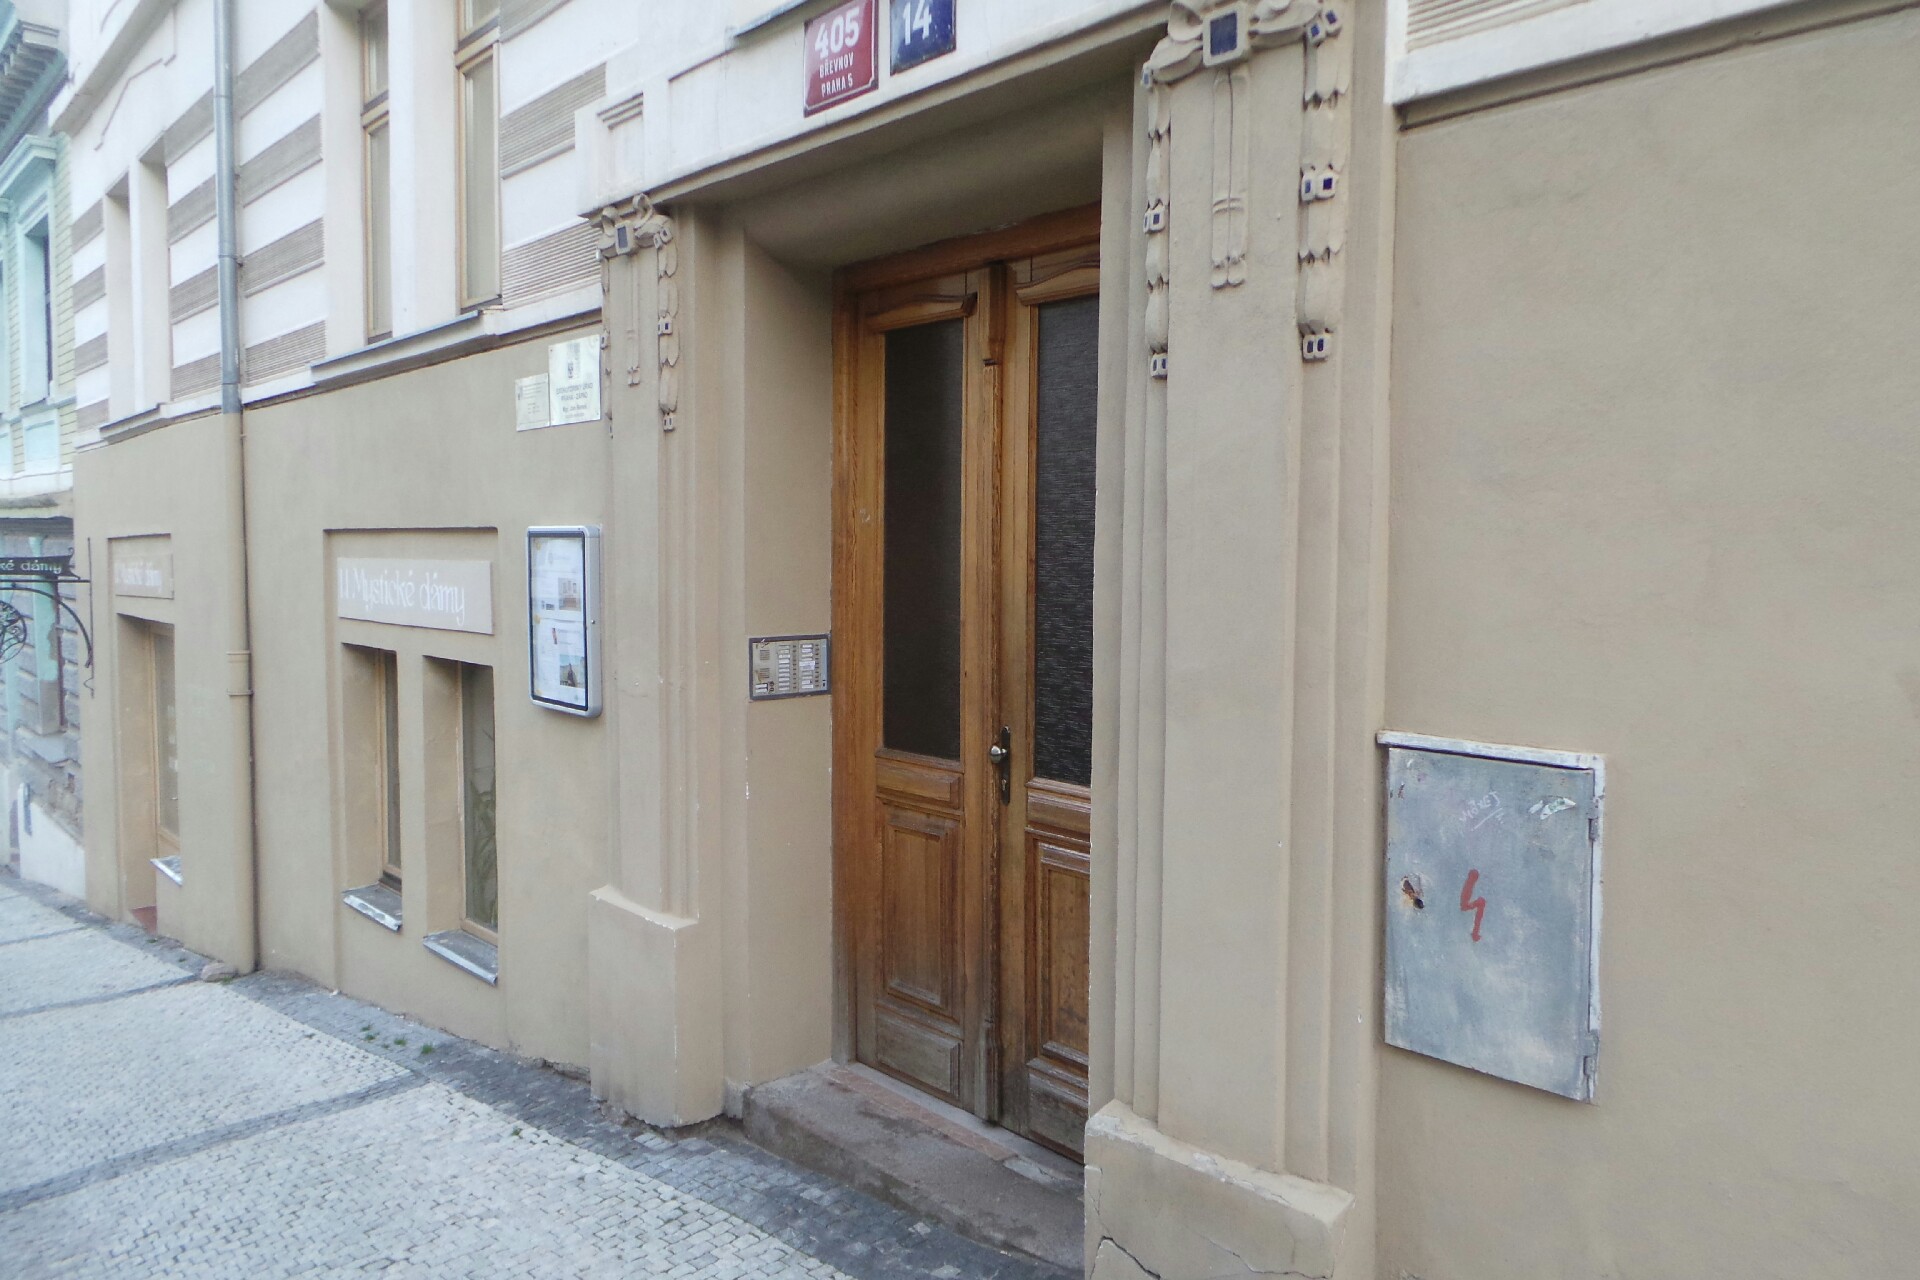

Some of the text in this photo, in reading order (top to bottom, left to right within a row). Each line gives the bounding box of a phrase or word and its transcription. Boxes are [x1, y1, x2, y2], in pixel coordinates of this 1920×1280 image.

[815, 7, 860, 59] 405
[903, 0, 932, 45] 14
[819, 51, 854, 79] BŘEVNOV
[821, 77, 846, 97] PRAHA
[21, 559, 62, 574] dámy
[352, 567, 416, 612] Mystické
[419, 571, 466, 627] dámy
